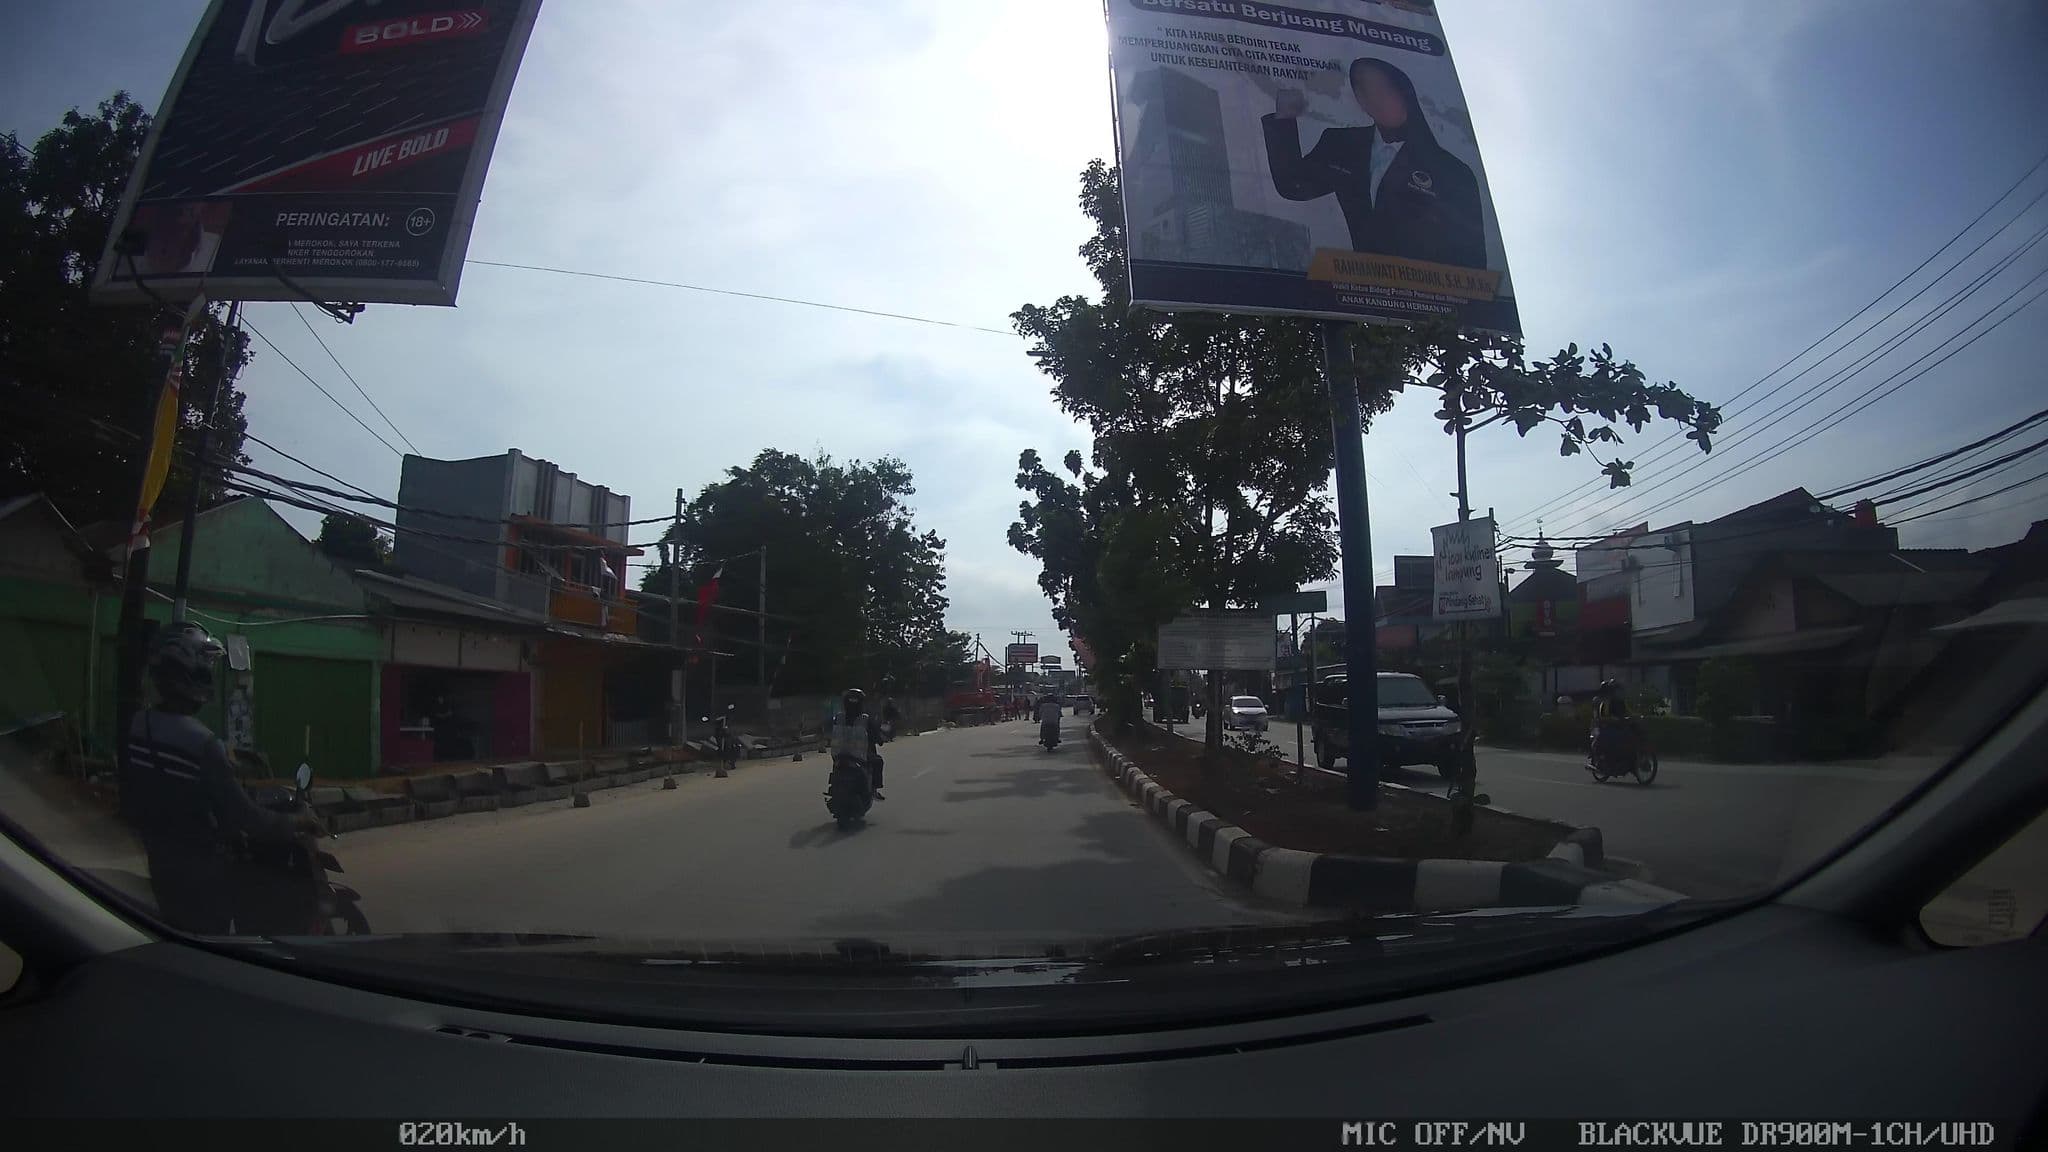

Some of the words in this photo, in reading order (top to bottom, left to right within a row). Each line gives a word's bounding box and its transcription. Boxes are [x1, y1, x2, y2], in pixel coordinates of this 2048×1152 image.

[355, 16, 454, 45] BOLD
[1240, 3, 1345, 33] Berjuang
[1349, 19, 1432, 51] Menang
[1165, 28, 1187, 38] KITA
[1190, 30, 1226, 42] HARUS
[1227, 34, 1268, 49] BERDIRI
[1268, 40, 1301, 53] TEGAK
[1118, 36, 1219, 55] MEMPERJUANGKAN
[1221, 46, 1244, 58] CITA
[1245, 49, 1267, 61] CITA
[1268, 53, 1341, 72] KEMERDEKAAN
[1151, 52, 1186, 66] UNTUK
[1187, 57, 1271, 76] KESEJAHTERAAN
[352, 143, 397, 177] LIVE
[397, 128, 450, 161] BOLD
[275, 212, 391, 227] PERINGATAN:
[410, 215, 432, 228] 18+
[338, 240, 359, 248] SAYA
[362, 240, 400, 249] TERKENA
[1341, 295, 1365, 305] ANAK
[1365, 297, 1406, 309] KANDUNG
[1406, 301, 1440, 313] HERMAN
